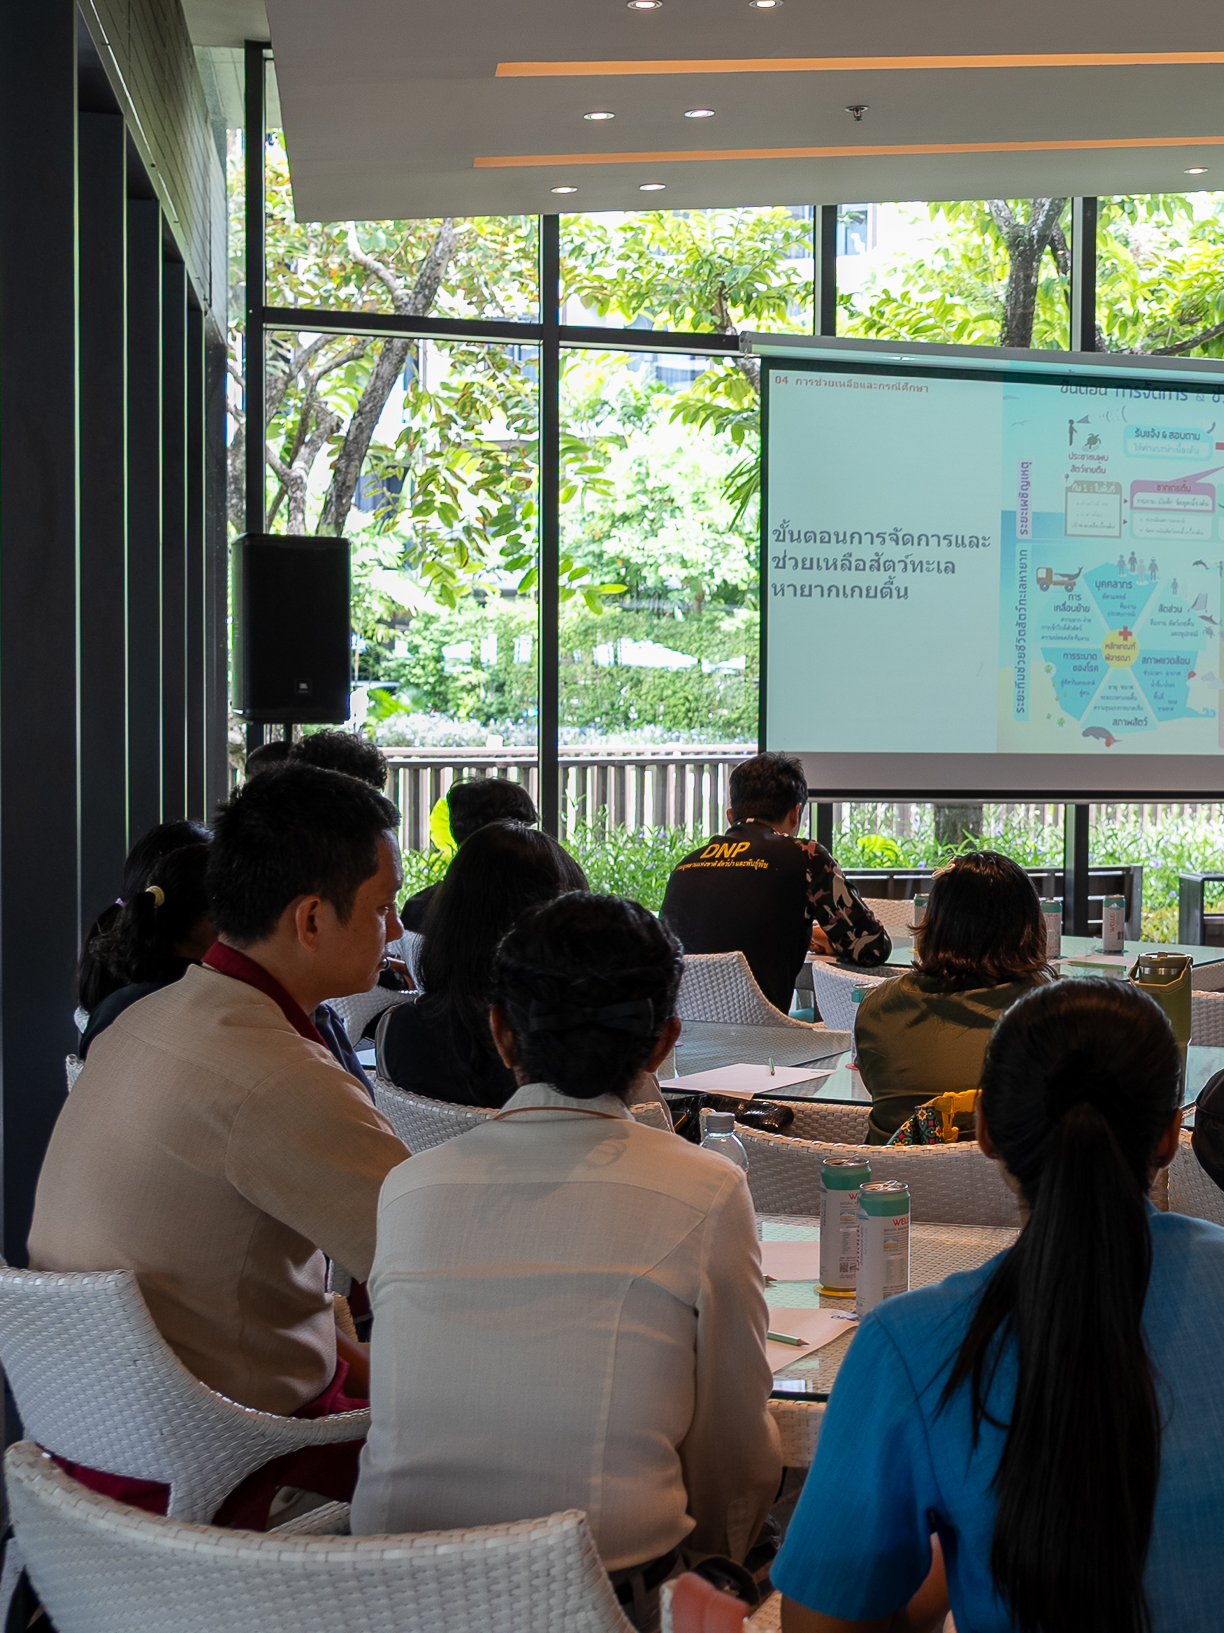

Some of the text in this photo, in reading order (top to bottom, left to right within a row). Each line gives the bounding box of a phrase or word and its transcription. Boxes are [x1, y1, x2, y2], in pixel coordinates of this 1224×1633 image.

[774, 375, 929, 393] 04 การช่วยเหลือและกรณีศึกษา
[1018, 461, 1032, 536] ระยะเผชิญเหตุ
[771, 519, 992, 549] ขั้นตอนการจัดการและ
[771, 549, 956, 575] ช่วยเหลือสัตว์ทะเล
[771, 575, 909, 600] หายากเกยตื้น
[1068, 593, 1082, 601] การ
[1053, 601, 1091, 613] เคลื่อนย้าย
[1158, 603, 1183, 613] สัดส่วน
[1062, 652, 1098, 661] การระบาด
[1141, 655, 1191, 666] สภาพแวดล้อม
[1112, 716, 1148, 727] สภาพสัตว์
[700, 841, 751, 859] DNP
